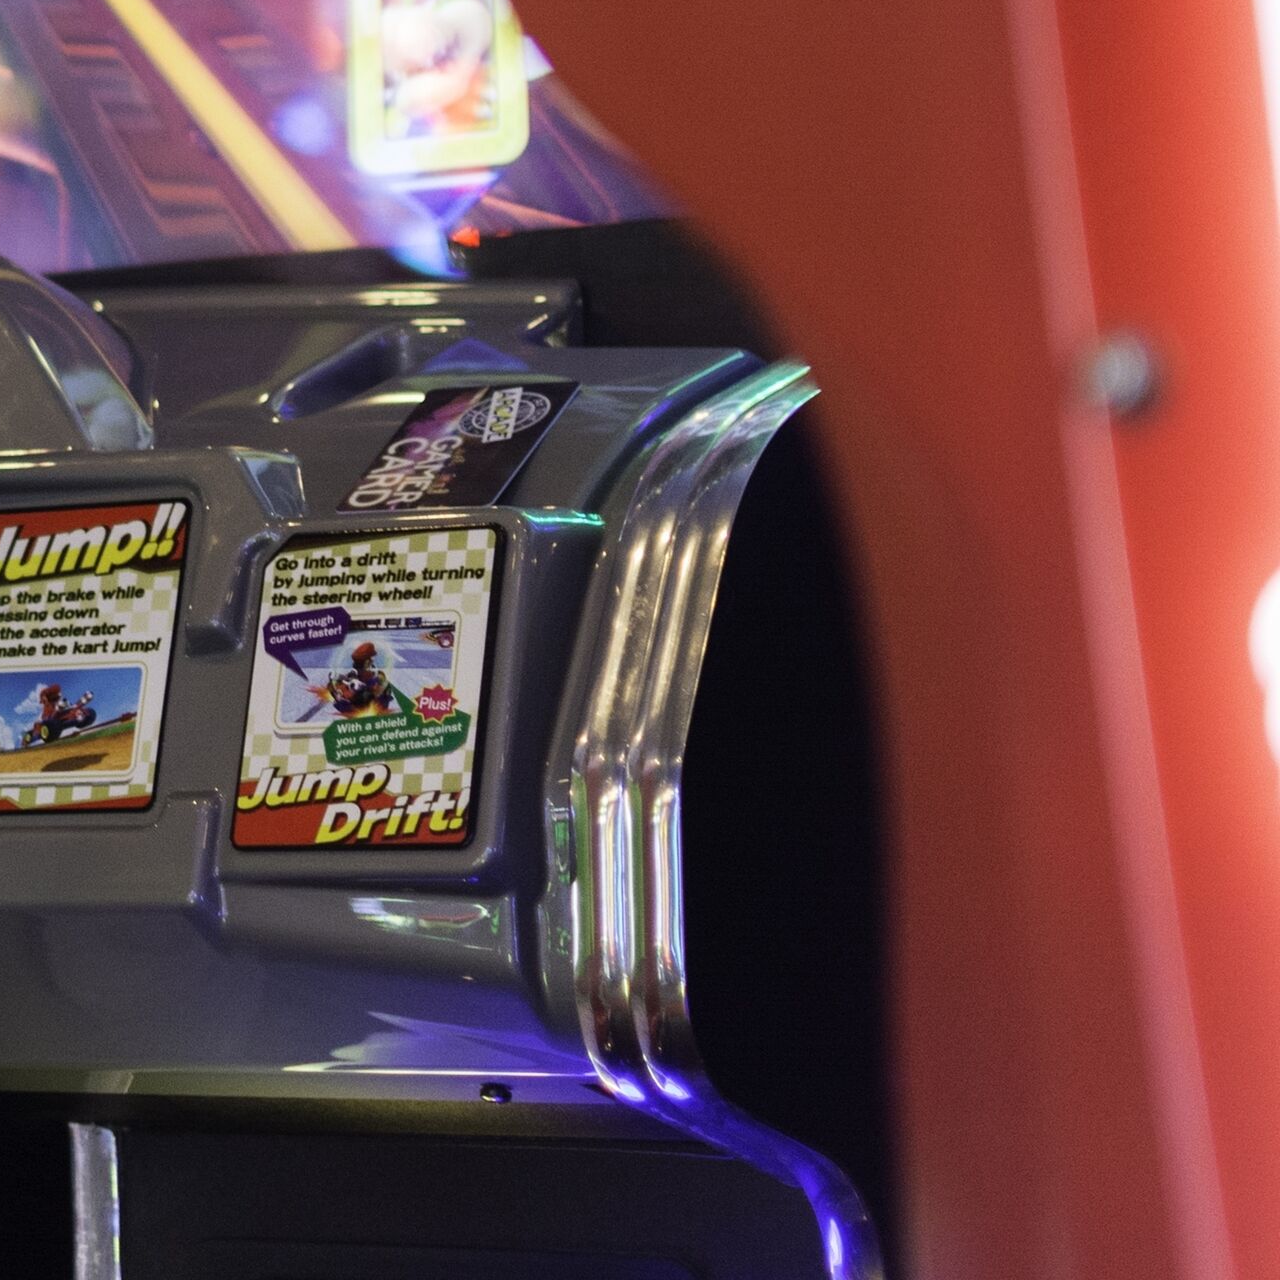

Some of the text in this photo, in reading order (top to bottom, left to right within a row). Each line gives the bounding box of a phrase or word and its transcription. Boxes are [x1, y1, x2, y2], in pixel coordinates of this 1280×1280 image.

[348, 436, 429, 508] CARD
[387, 435, 463, 506] GAMER
[275, 551, 397, 571] Go into a drift
[273, 575, 293, 590] by
[372, 569, 416, 584] while
[421, 566, 485, 582] turning
[17, 589, 41, 604] the
[47, 588, 95, 603] brake
[102, 586, 145, 600] while
[271, 585, 434, 606] the steering wheel!
[53, 606, 99, 620] down
[0, 624, 24, 639] the
[29, 622, 126, 638] accelerator
[270, 615, 334, 634] Get through
[269, 626, 342, 645] curves faster!
[41, 640, 67, 656] the
[72, 640, 109, 655] kart
[419, 695, 452, 711] Plus!
[336, 717, 407, 735] With a shield
[336, 722, 462, 748] you can defend against
[336, 738, 444, 761] your rival's attacks!
[237, 763, 390, 810] Jump
[314, 787, 471, 844] Drift!
